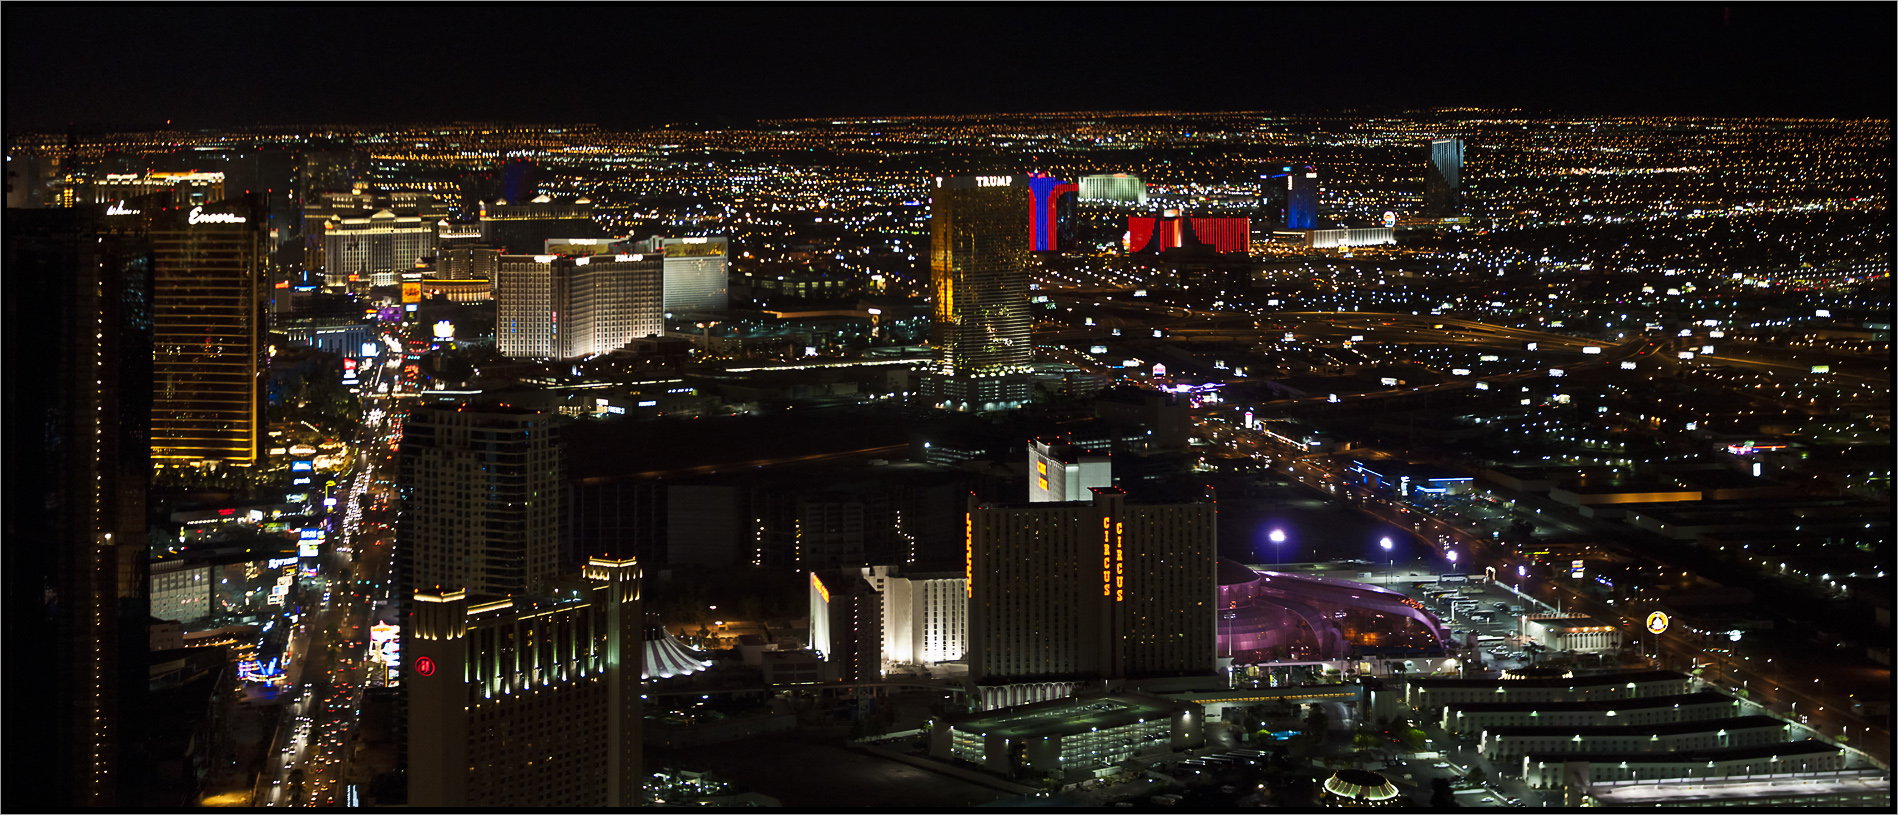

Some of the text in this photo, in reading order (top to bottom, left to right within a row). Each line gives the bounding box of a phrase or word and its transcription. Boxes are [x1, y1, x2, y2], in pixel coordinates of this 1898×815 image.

[975, 175, 1012, 188] TRUMP
[1102, 516, 1111, 597] CIRCUS
[1115, 521, 1124, 602] CIRCUS
